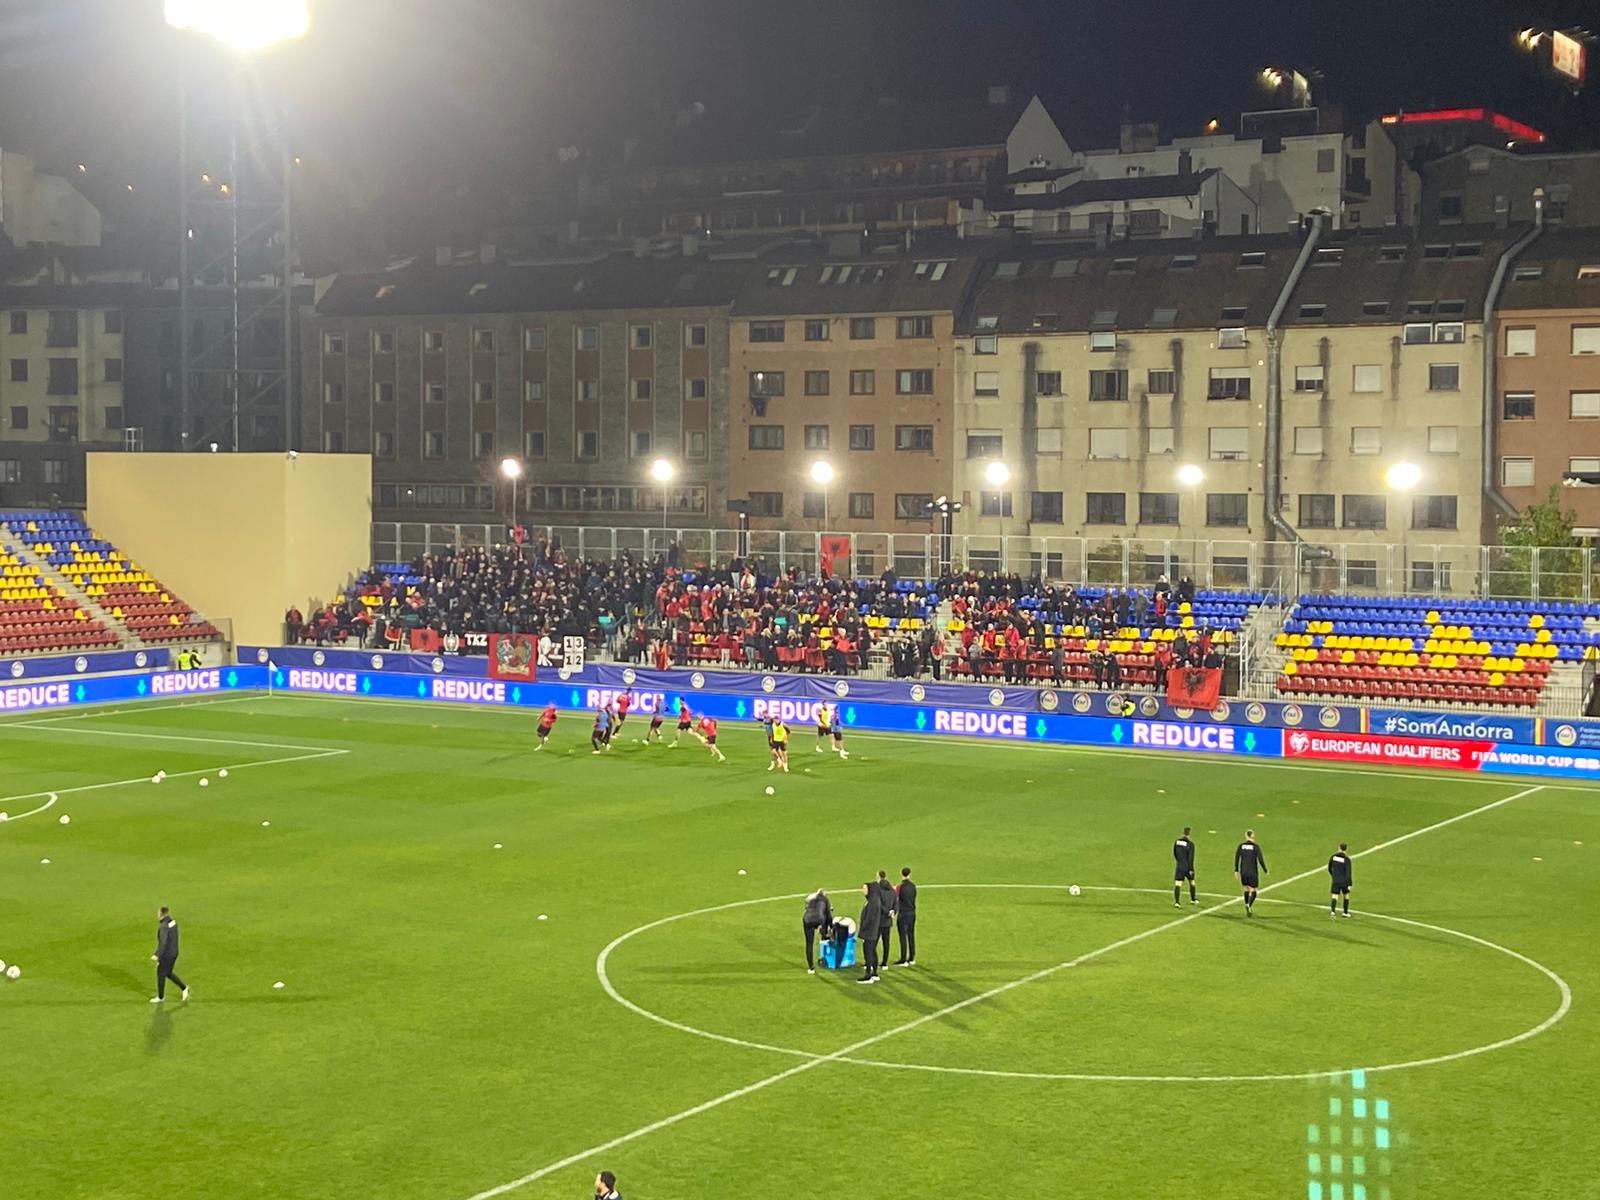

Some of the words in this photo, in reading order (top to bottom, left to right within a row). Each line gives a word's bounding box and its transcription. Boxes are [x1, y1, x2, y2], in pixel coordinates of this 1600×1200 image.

[464, 633, 488, 646] TKZ
[151, 670, 220, 694] REDUCE
[289, 669, 357, 692] REDUCE
[432, 679, 505, 703] REDUCE
[935, 710, 1028, 736] REDUCE
[1385, 717, 1513, 740] #SomAndorra
[1133, 722, 1234, 750] REDUCE
[1311, 739, 1381, 756] EUROPEAN
[1384, 743, 1460, 762] QUALIFIERS
[1471, 751, 1498, 763] FIFA
[1500, 752, 1545, 766] WORLD
[1547, 756, 1573, 768] CUP
